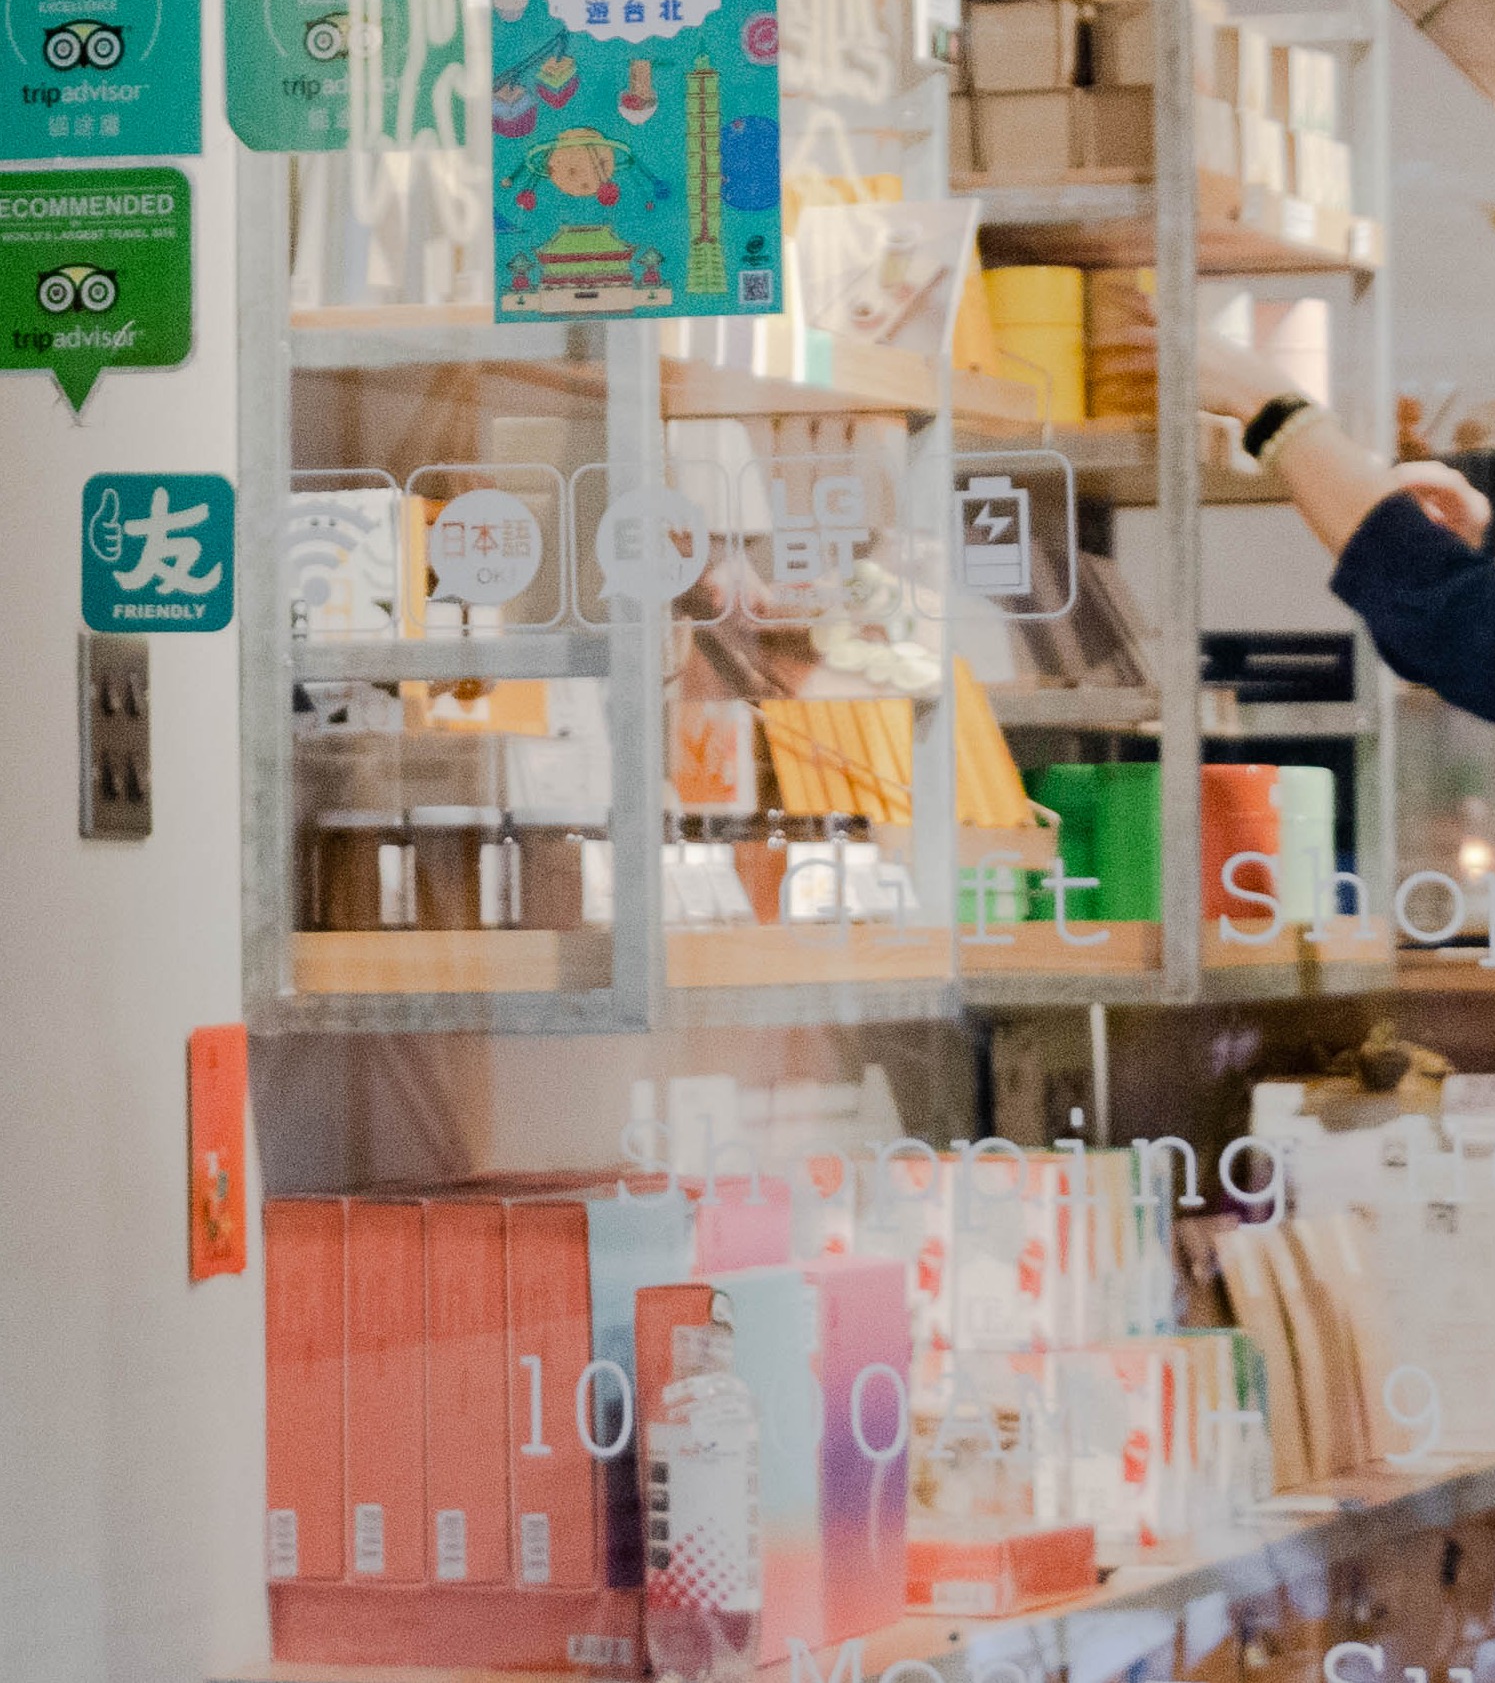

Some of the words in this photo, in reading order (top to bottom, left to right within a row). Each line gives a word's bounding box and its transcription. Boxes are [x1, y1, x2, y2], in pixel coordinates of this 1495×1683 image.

[22, 80, 143, 108] tripadvisor
[13, 324, 136, 354] tripadvisor
[111, 486, 223, 596] 友
[442, 519, 533, 559] 日本語
[112, 603, 207, 619] FRIENDLY
[618, 1106, 1288, 1232] Shopping
